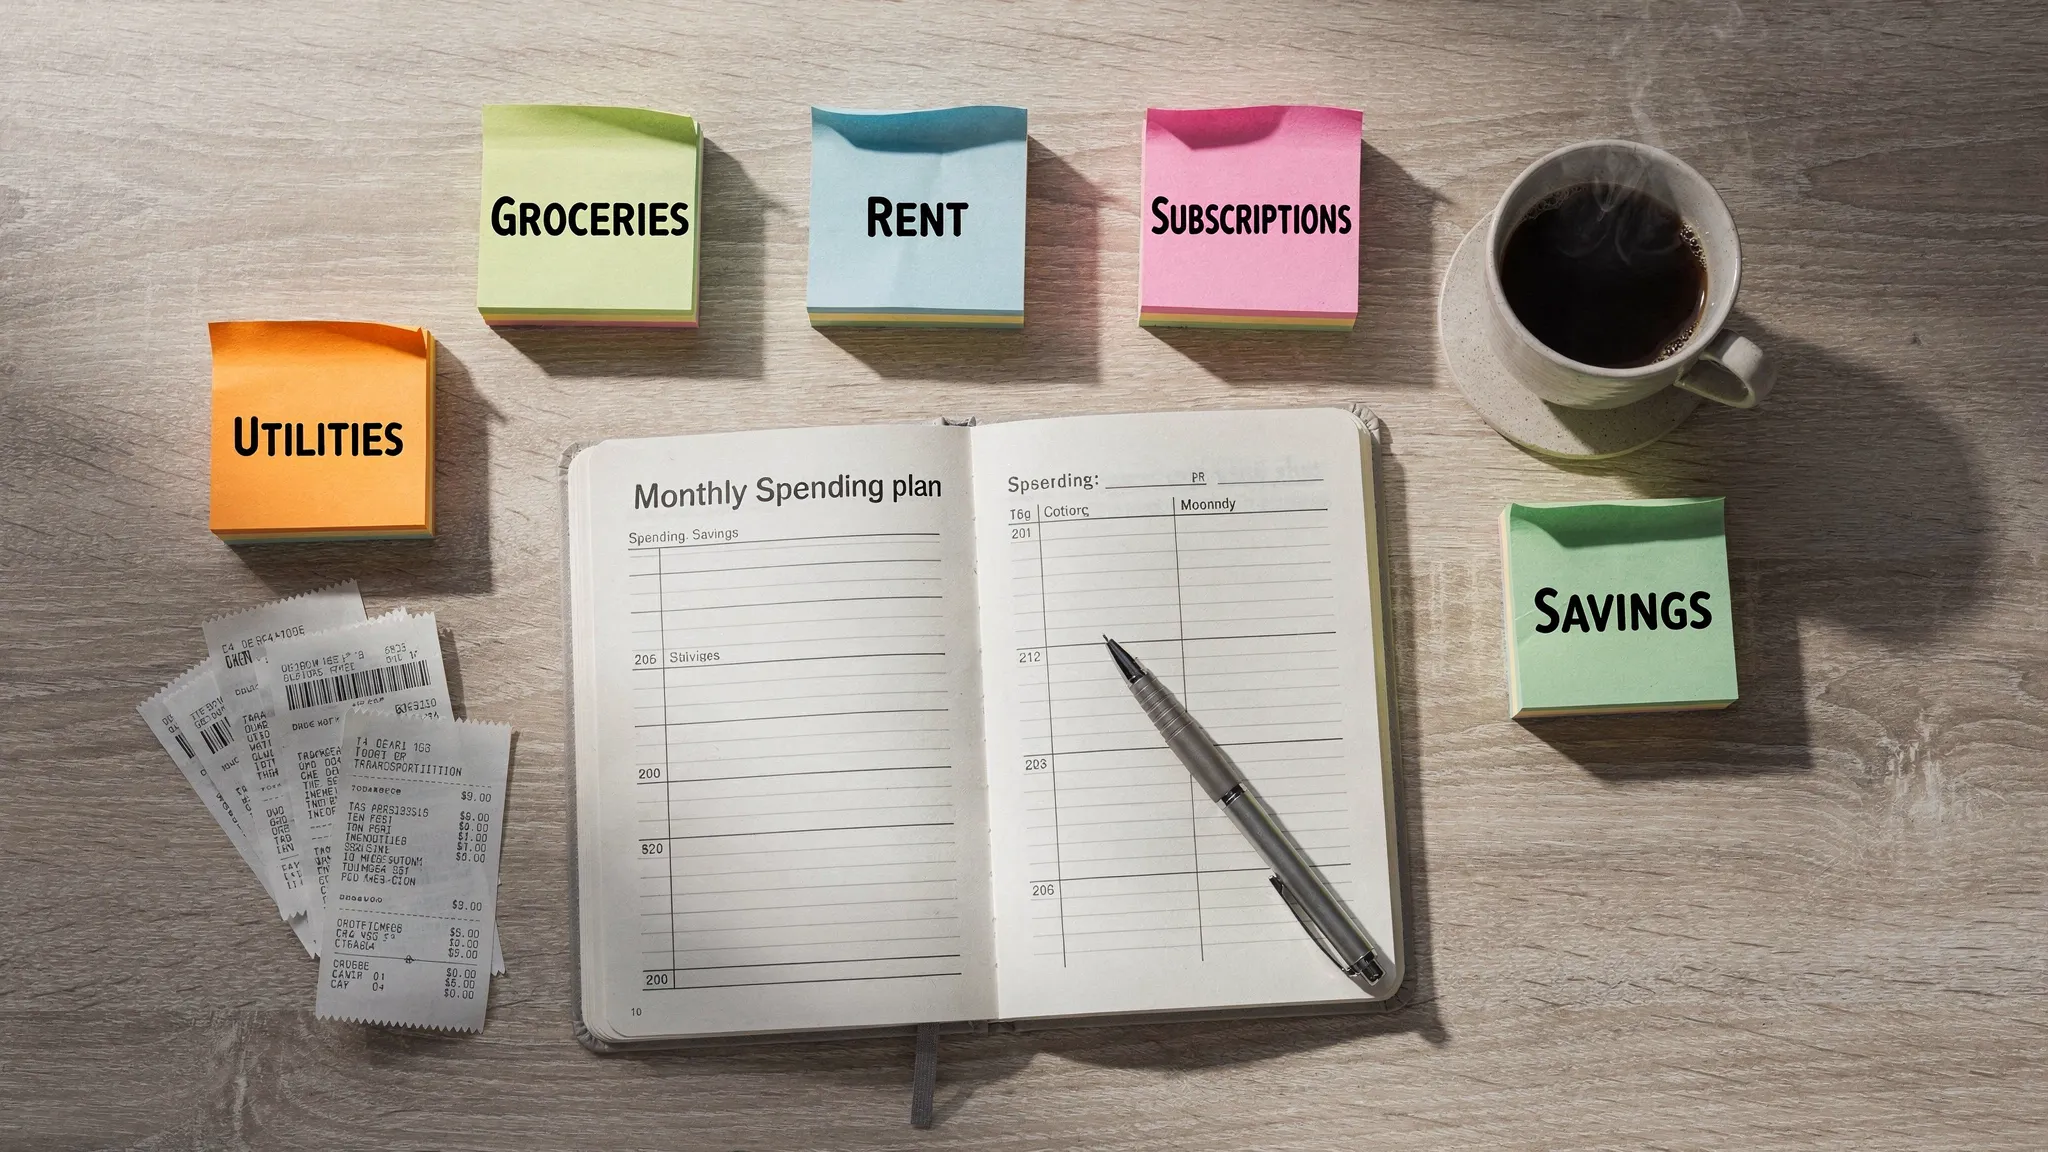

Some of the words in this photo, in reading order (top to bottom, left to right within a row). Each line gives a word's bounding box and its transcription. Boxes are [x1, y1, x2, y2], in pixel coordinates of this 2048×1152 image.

[634, 479, 748, 511] Monthly
[755, 474, 884, 507] Spending
[892, 473, 942, 503] plan
[692, 527, 739, 543] Savings
[1011, 527, 1031, 540] 201
[634, 653, 657, 665] 206
[1019, 651, 1041, 663] 212
[638, 768, 661, 779] 200
[1032, 884, 1055, 897] 206
[646, 974, 669, 986] 200
[630, 1008, 642, 1017] 10
